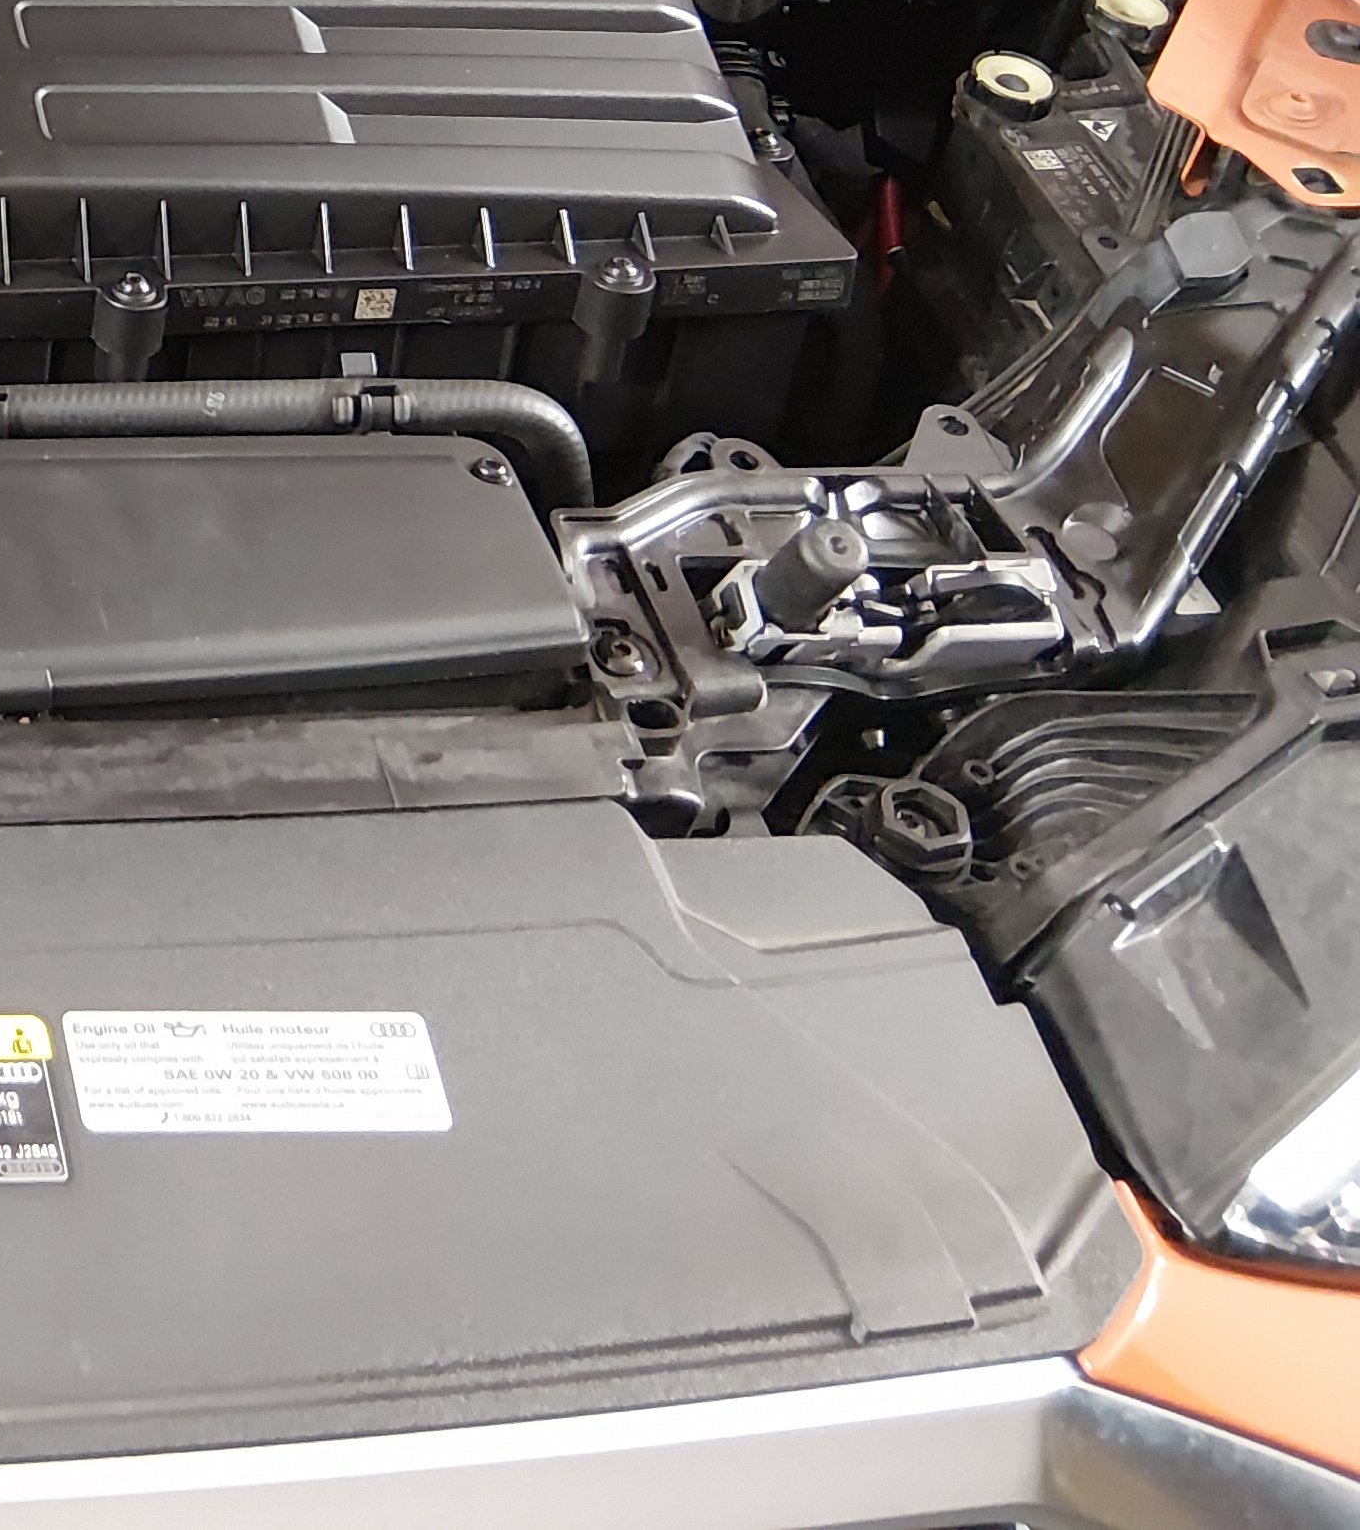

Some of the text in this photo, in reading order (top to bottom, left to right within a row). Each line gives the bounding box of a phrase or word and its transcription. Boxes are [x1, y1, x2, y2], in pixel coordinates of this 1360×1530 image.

[72, 1022, 156, 1036] Engine Oil
[222, 1023, 330, 1035] Huile moteur
[75, 1040, 160, 1052] Use only oil that
[181, 1055, 204, 1063] with
[163, 1069, 199, 1080] SAE
[266, 1070, 278, 1080] &
[284, 1070, 316, 1080] VW
[358, 1070, 379, 1080] 00
[133, 1085, 145, 1094] of
[148, 1086, 199, 1096] approved
[237, 1086, 261, 1095] Pour
